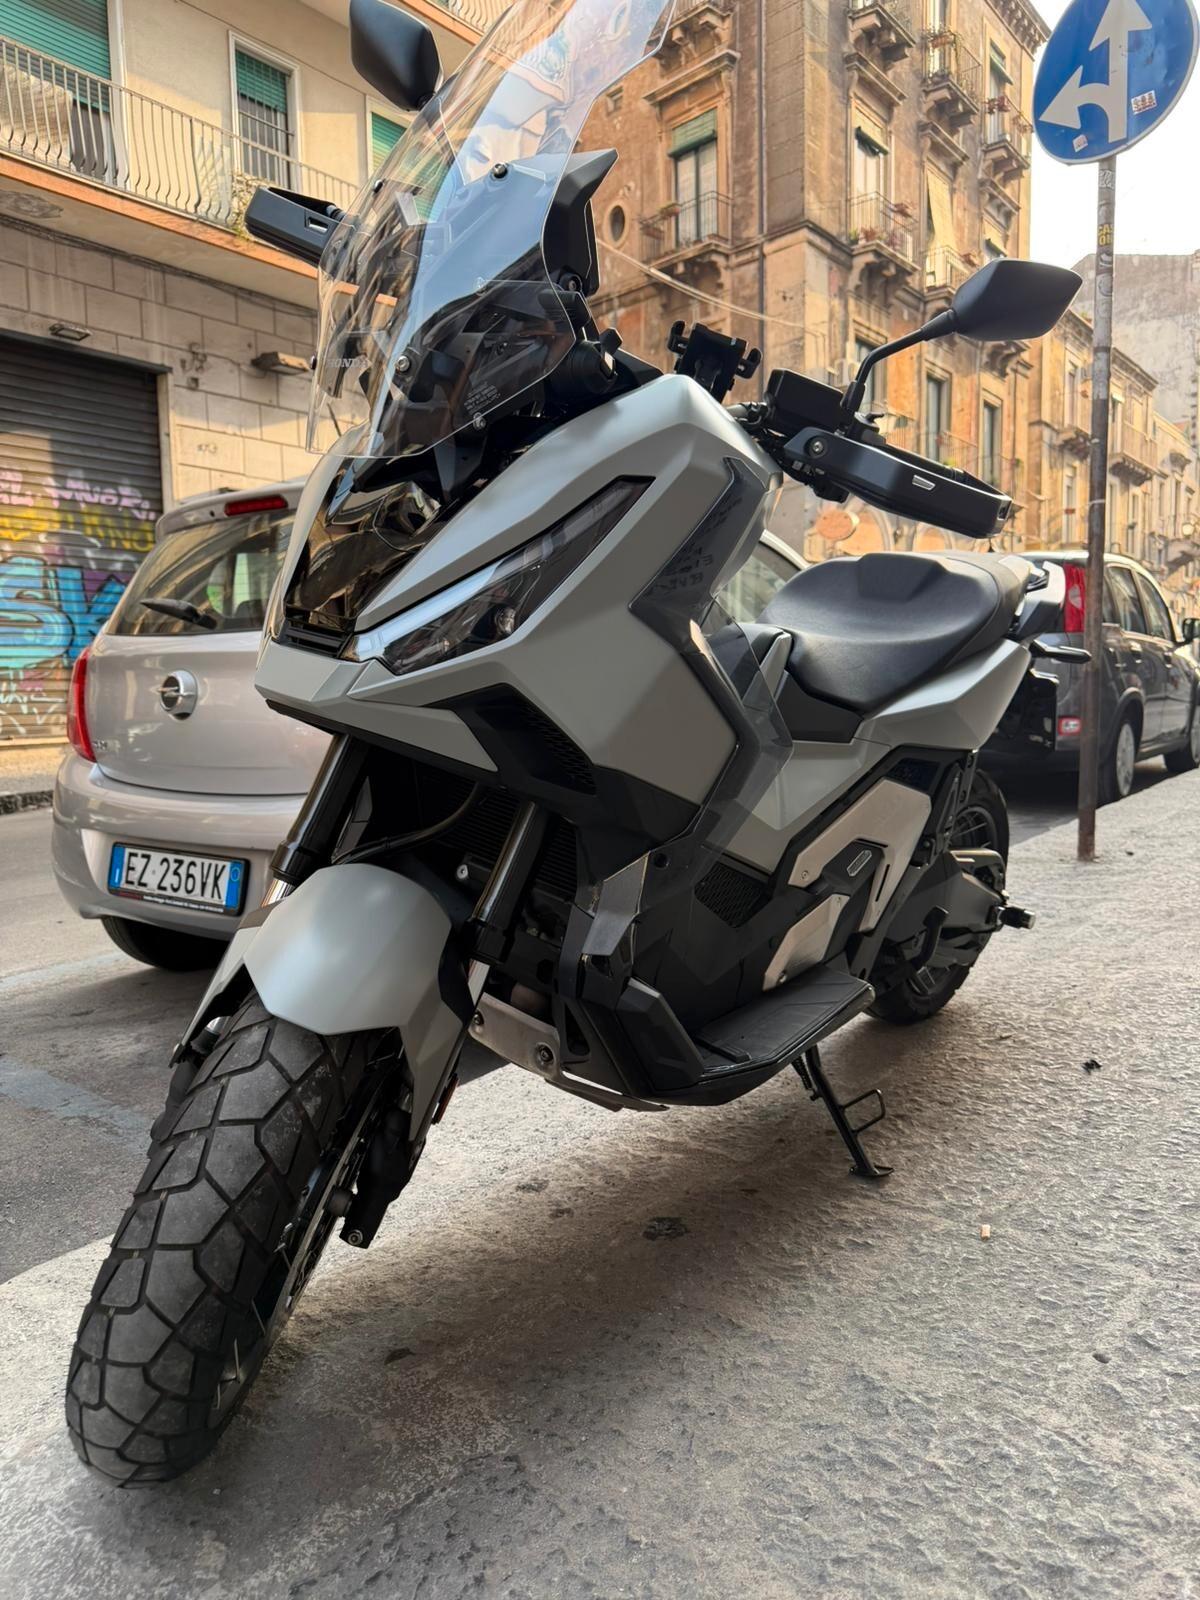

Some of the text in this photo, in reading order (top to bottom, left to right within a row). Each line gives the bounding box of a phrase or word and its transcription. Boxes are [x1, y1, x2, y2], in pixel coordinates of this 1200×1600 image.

[326, 358, 368, 369] HONDA
[125, 852, 226, 900] EZ 236VK
